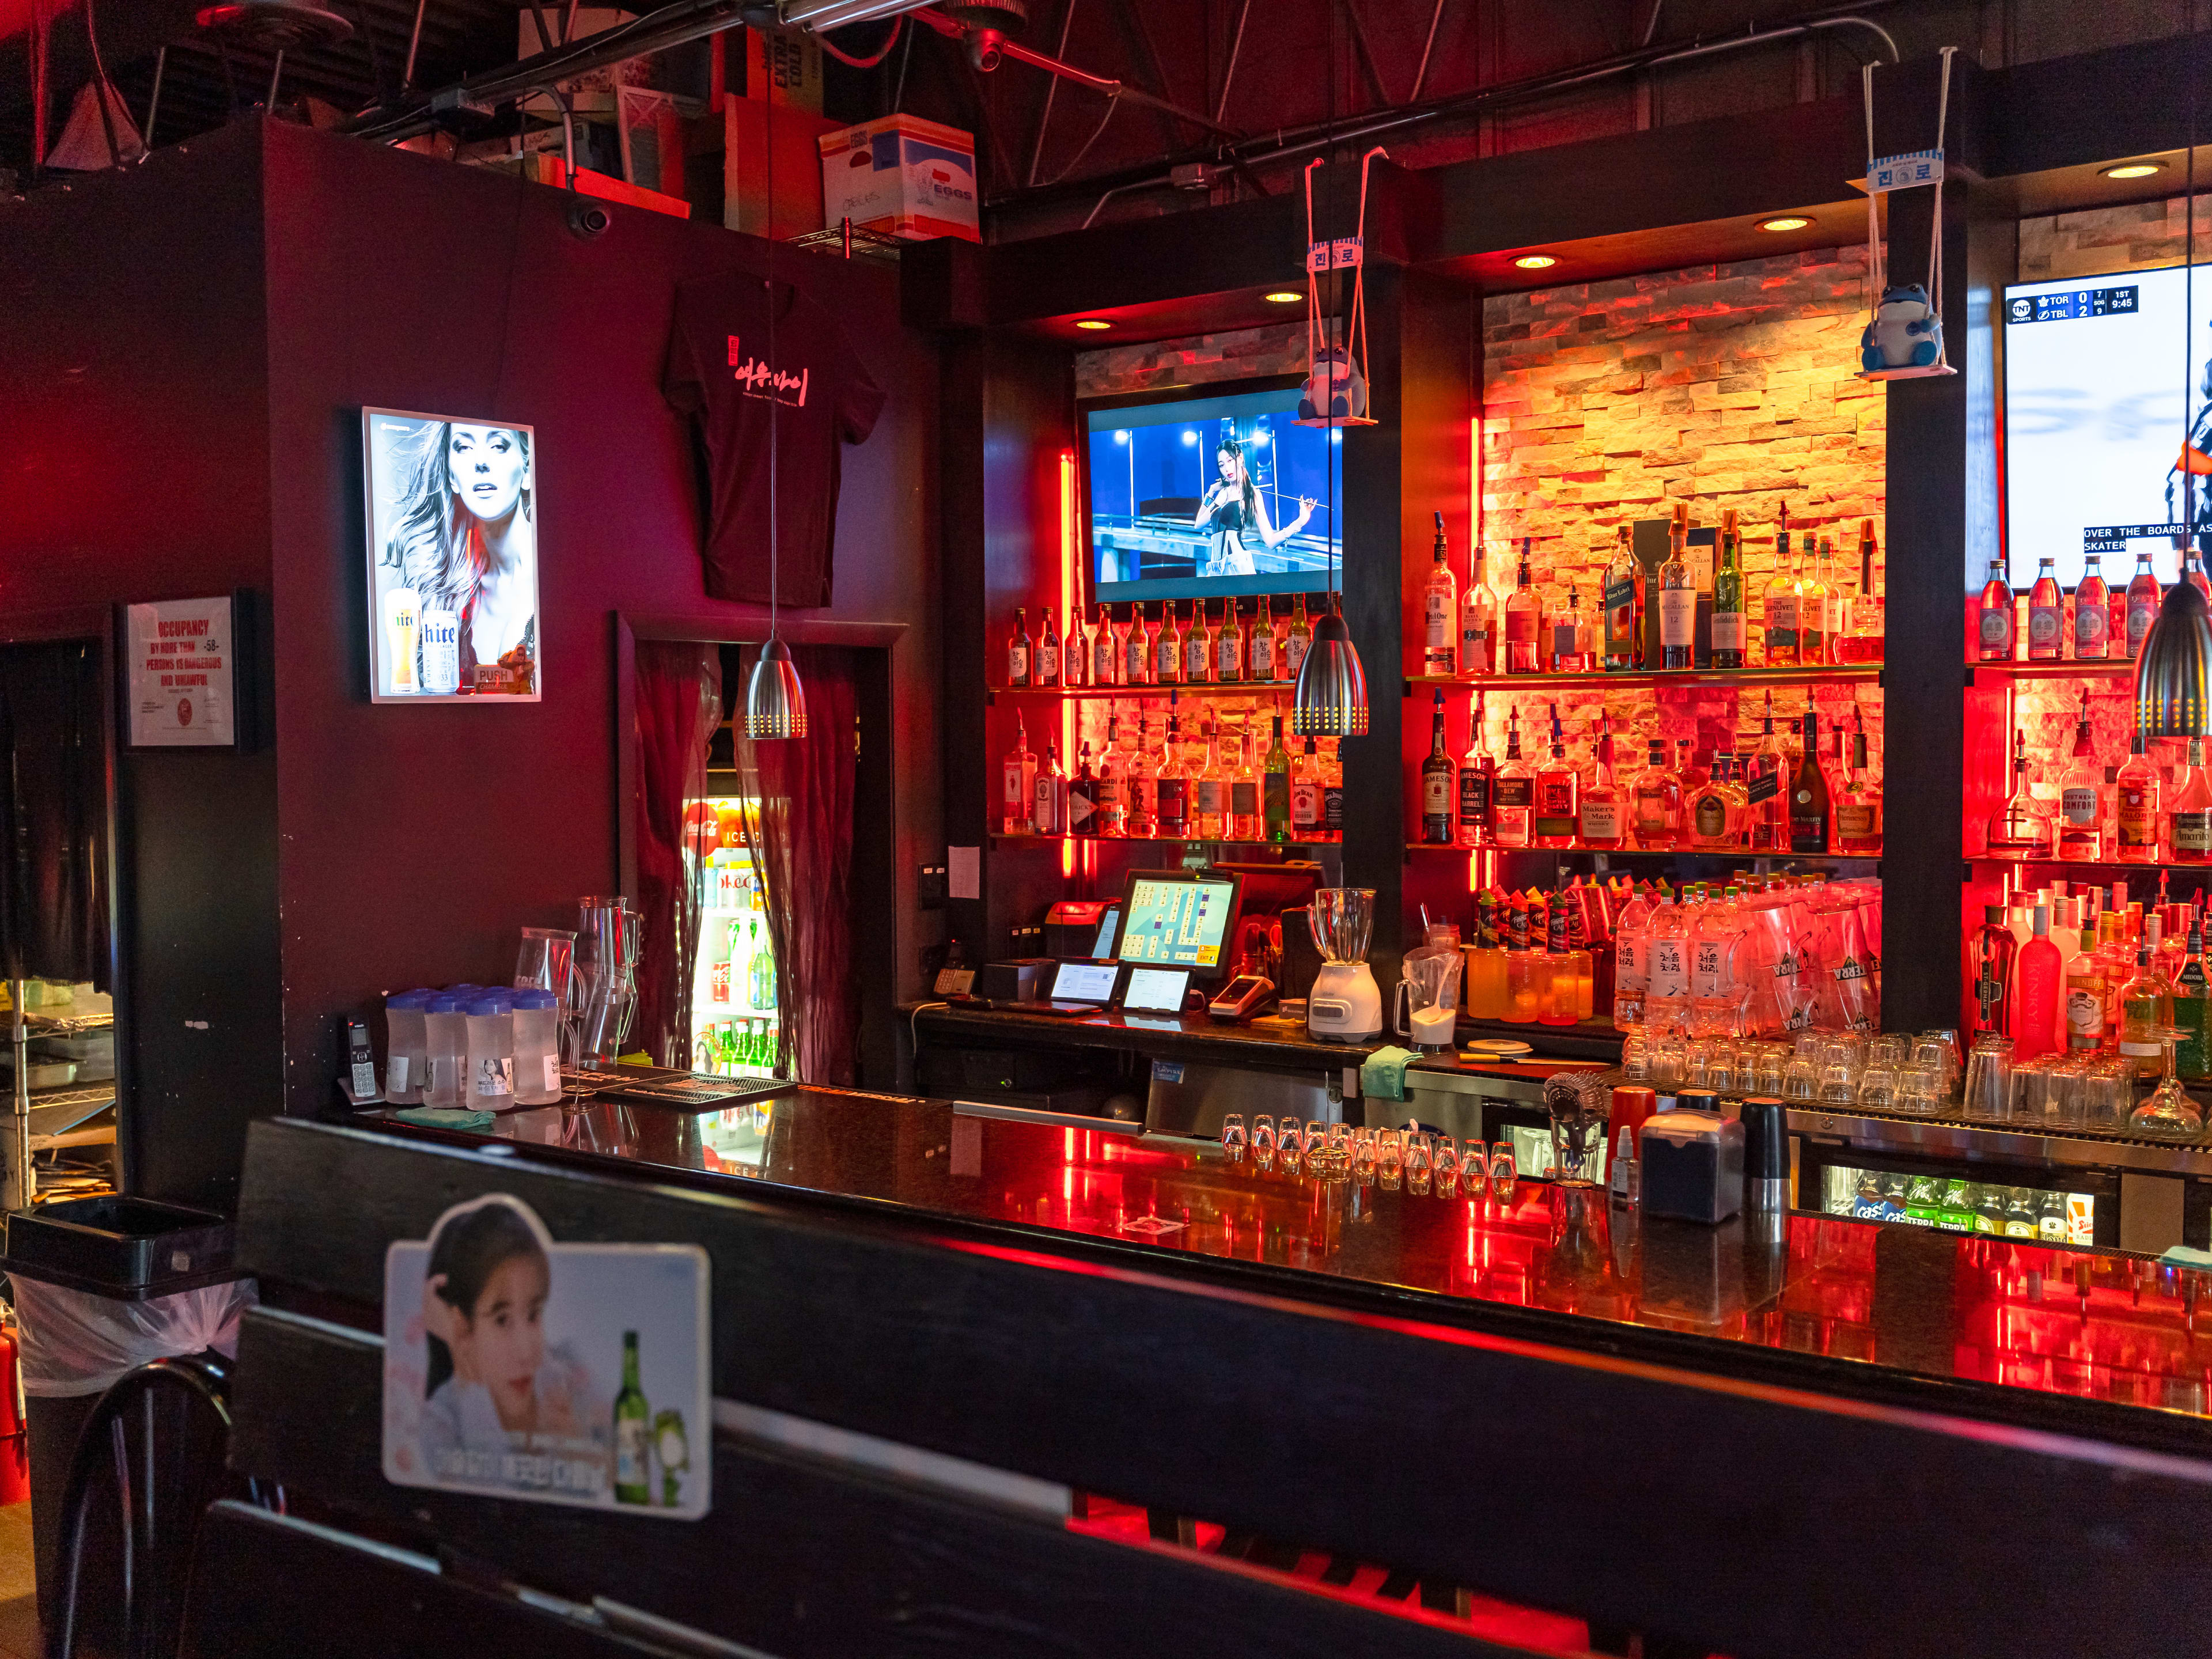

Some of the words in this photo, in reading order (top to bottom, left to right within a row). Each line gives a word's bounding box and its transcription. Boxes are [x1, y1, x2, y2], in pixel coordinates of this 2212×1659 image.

[789, 43, 802, 87] COLD
[934, 184, 972, 200] EGGS
[2050, 296, 2069, 305] TOR
[2078, 291, 2088, 304] 0
[2115, 290, 2130, 298] 1ST
[2012, 305, 2031, 314] TNT
[2112, 298, 2132, 308] 9:45
[2051, 309, 2069, 319] TBL
[2078, 305, 2088, 317] 2
[2084, 528, 2112, 537] OVER
[2119, 527, 2141, 536] THE
[2147, 525, 2191, 535] BOARDS
[2198, 524, 2212, 533] AS
[2084, 540, 2126, 551] SKATER
[1606, 590, 1618, 600] Blue
[1618, 586, 1631, 596] Label
[158, 619, 209, 638] OCCUPANCY
[425, 623, 455, 644] hite
[150, 642, 160, 654] BY
[160, 642, 177, 654] MORE
[179, 641, 195, 653] THAN
[146, 658, 174, 671] PERSONS
[176, 658, 184, 670] IS
[184, 657, 222, 669] DANGEROUS
[161, 674, 173, 686] AND
[175, 673, 208, 685] UNLAWFUL
[479, 671, 507, 680] PUSH
[1496, 780, 1524, 788] TULLAMORE
[2063, 801, 2096, 810] COMFORT
[726, 832, 747, 842] ICE
[2028, 964, 2041, 1021] KINKY
